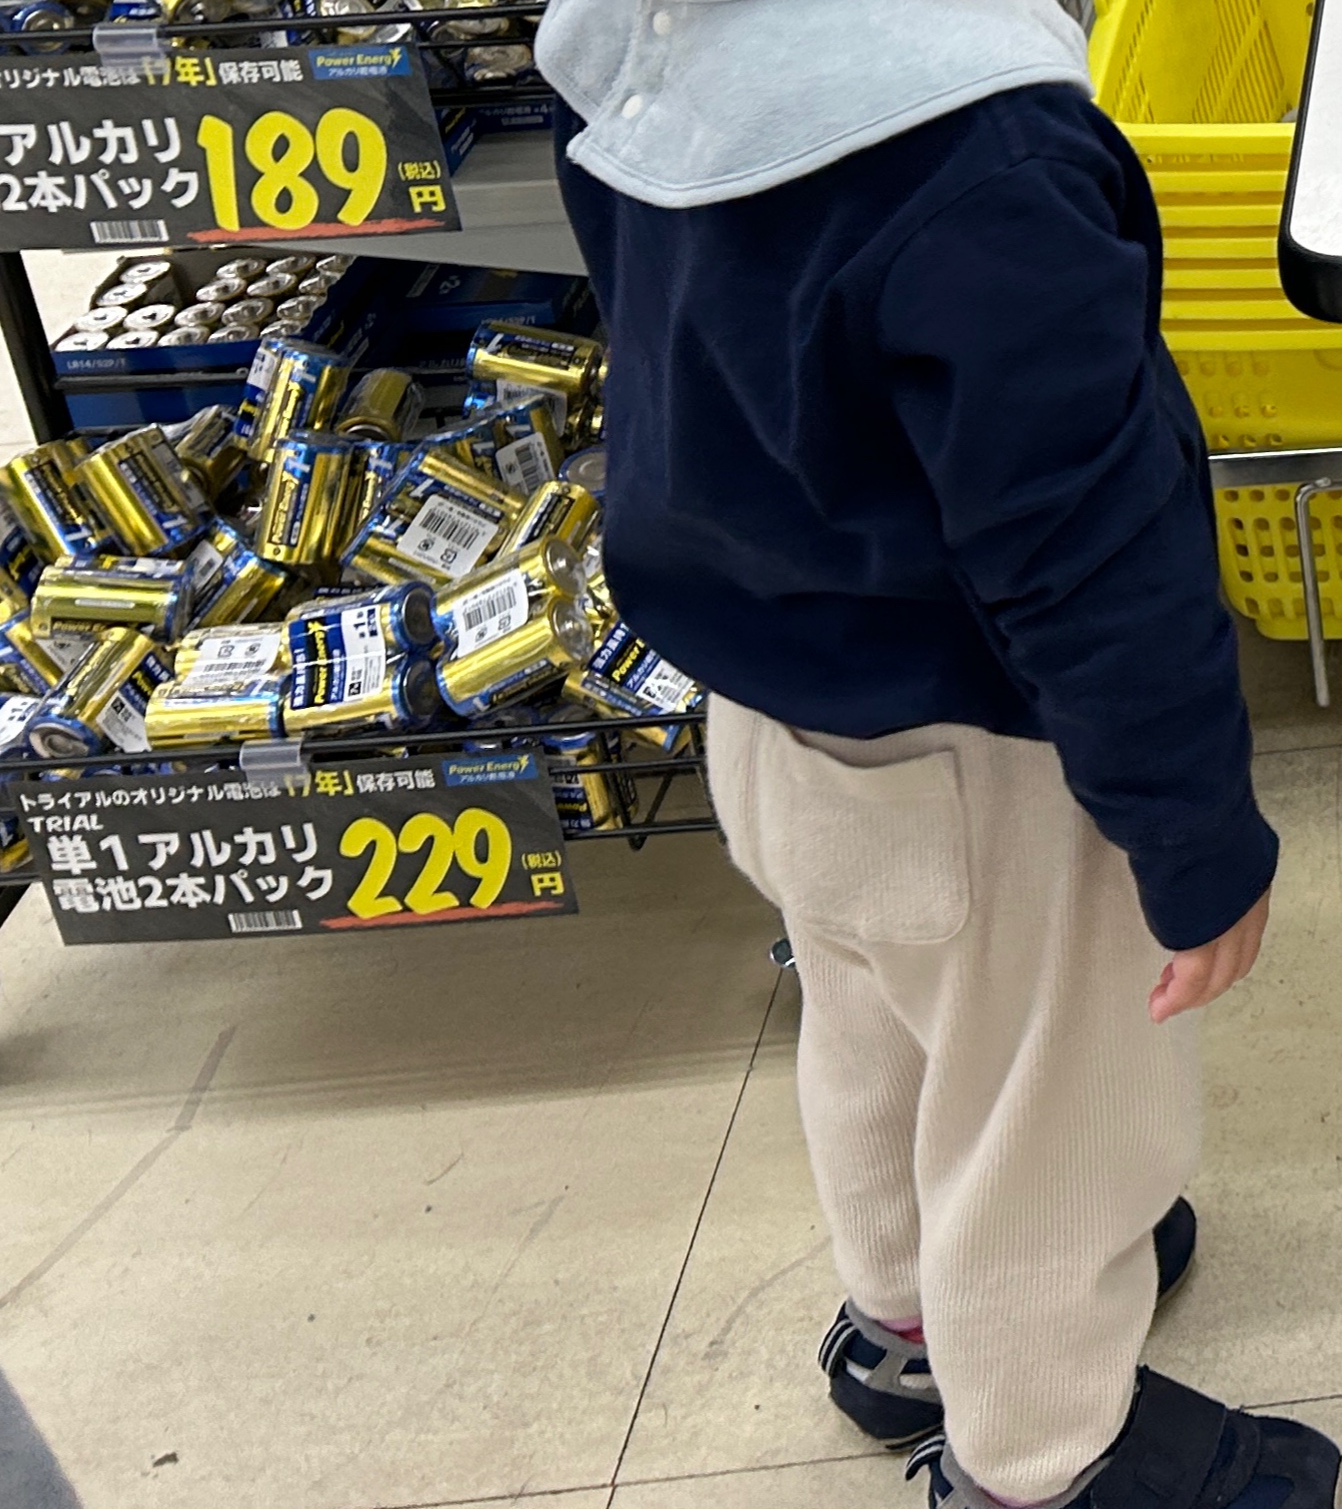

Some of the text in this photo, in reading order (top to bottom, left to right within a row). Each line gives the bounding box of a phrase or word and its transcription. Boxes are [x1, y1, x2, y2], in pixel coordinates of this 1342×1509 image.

[316, 55, 354, 69] Power
[0, 116, 182, 169] アルカリ
[197, 107, 388, 232] 189
[398, 160, 441, 182] (税込)
[0, 167, 199, 214] 2本パック
[408, 184, 446, 213] 円
[448, 763, 484, 776] Power
[27, 813, 105, 833] TRIAL
[47, 821, 320, 876] 単1アルカリ
[339, 807, 512, 920] 229
[53, 864, 335, 914] 電池2本パック
[532, 870, 564, 898] 円
